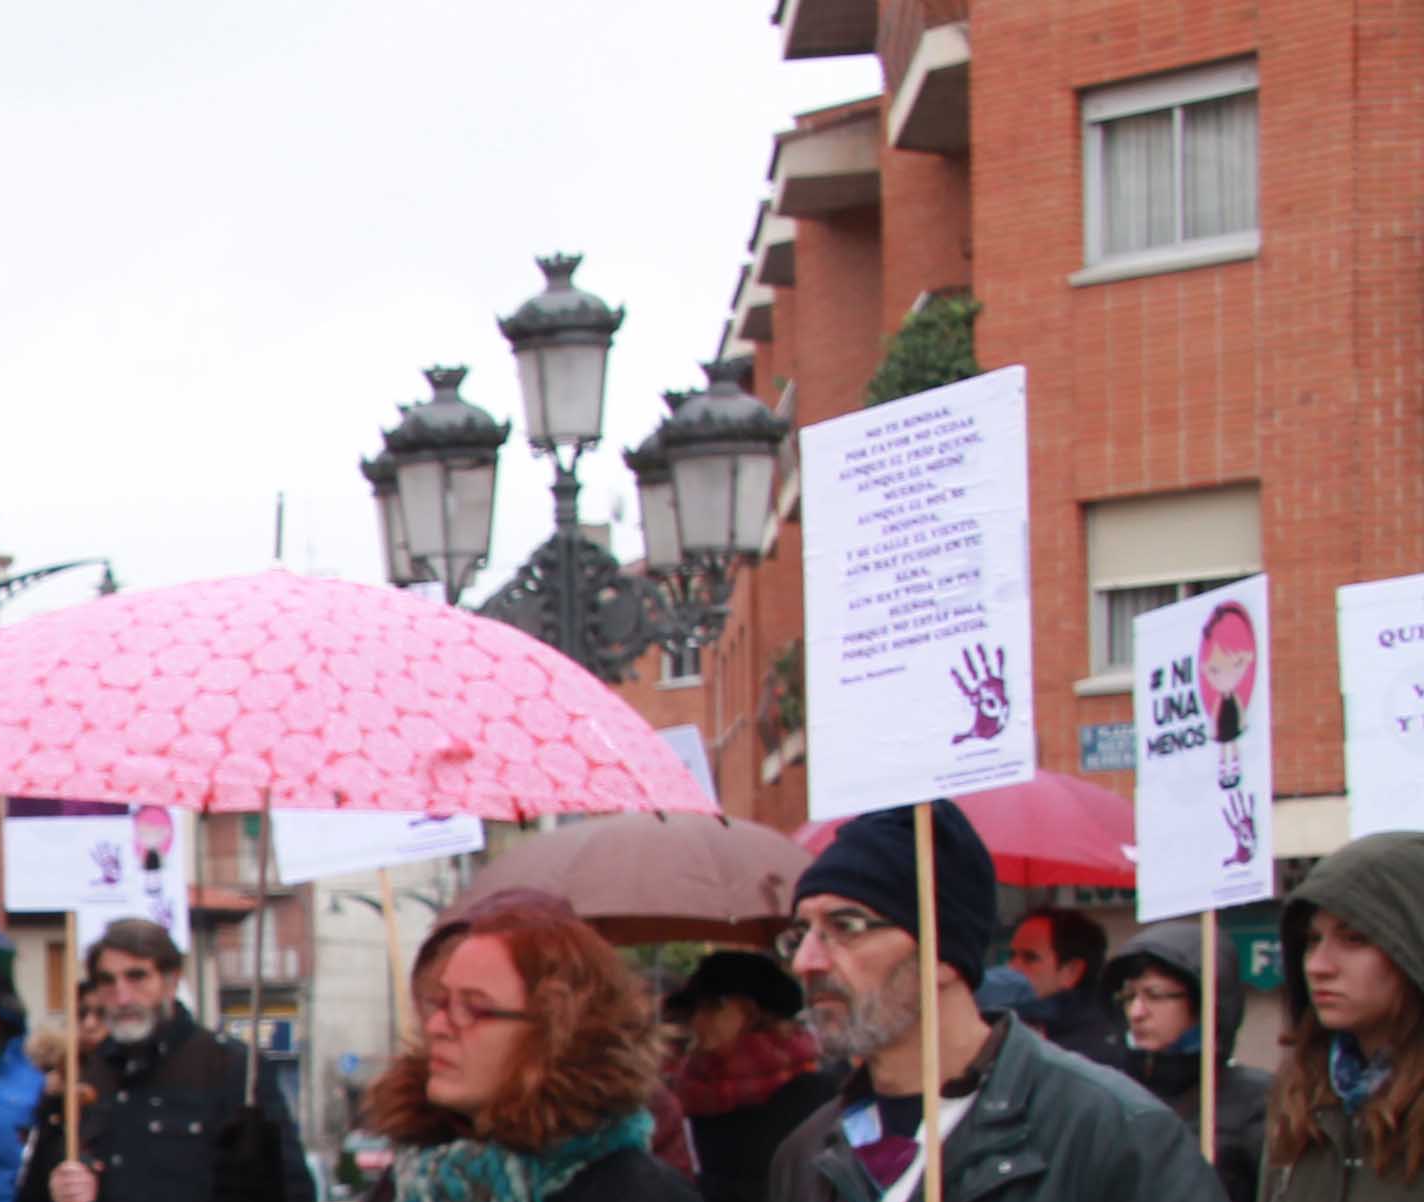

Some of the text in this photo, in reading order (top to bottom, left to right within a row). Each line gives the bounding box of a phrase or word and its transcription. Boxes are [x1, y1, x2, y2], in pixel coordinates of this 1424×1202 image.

[1153, 691, 1200, 726] UNA
[1396, 716, 1412, 733] Y
[1146, 723, 1206, 760] MENOS
